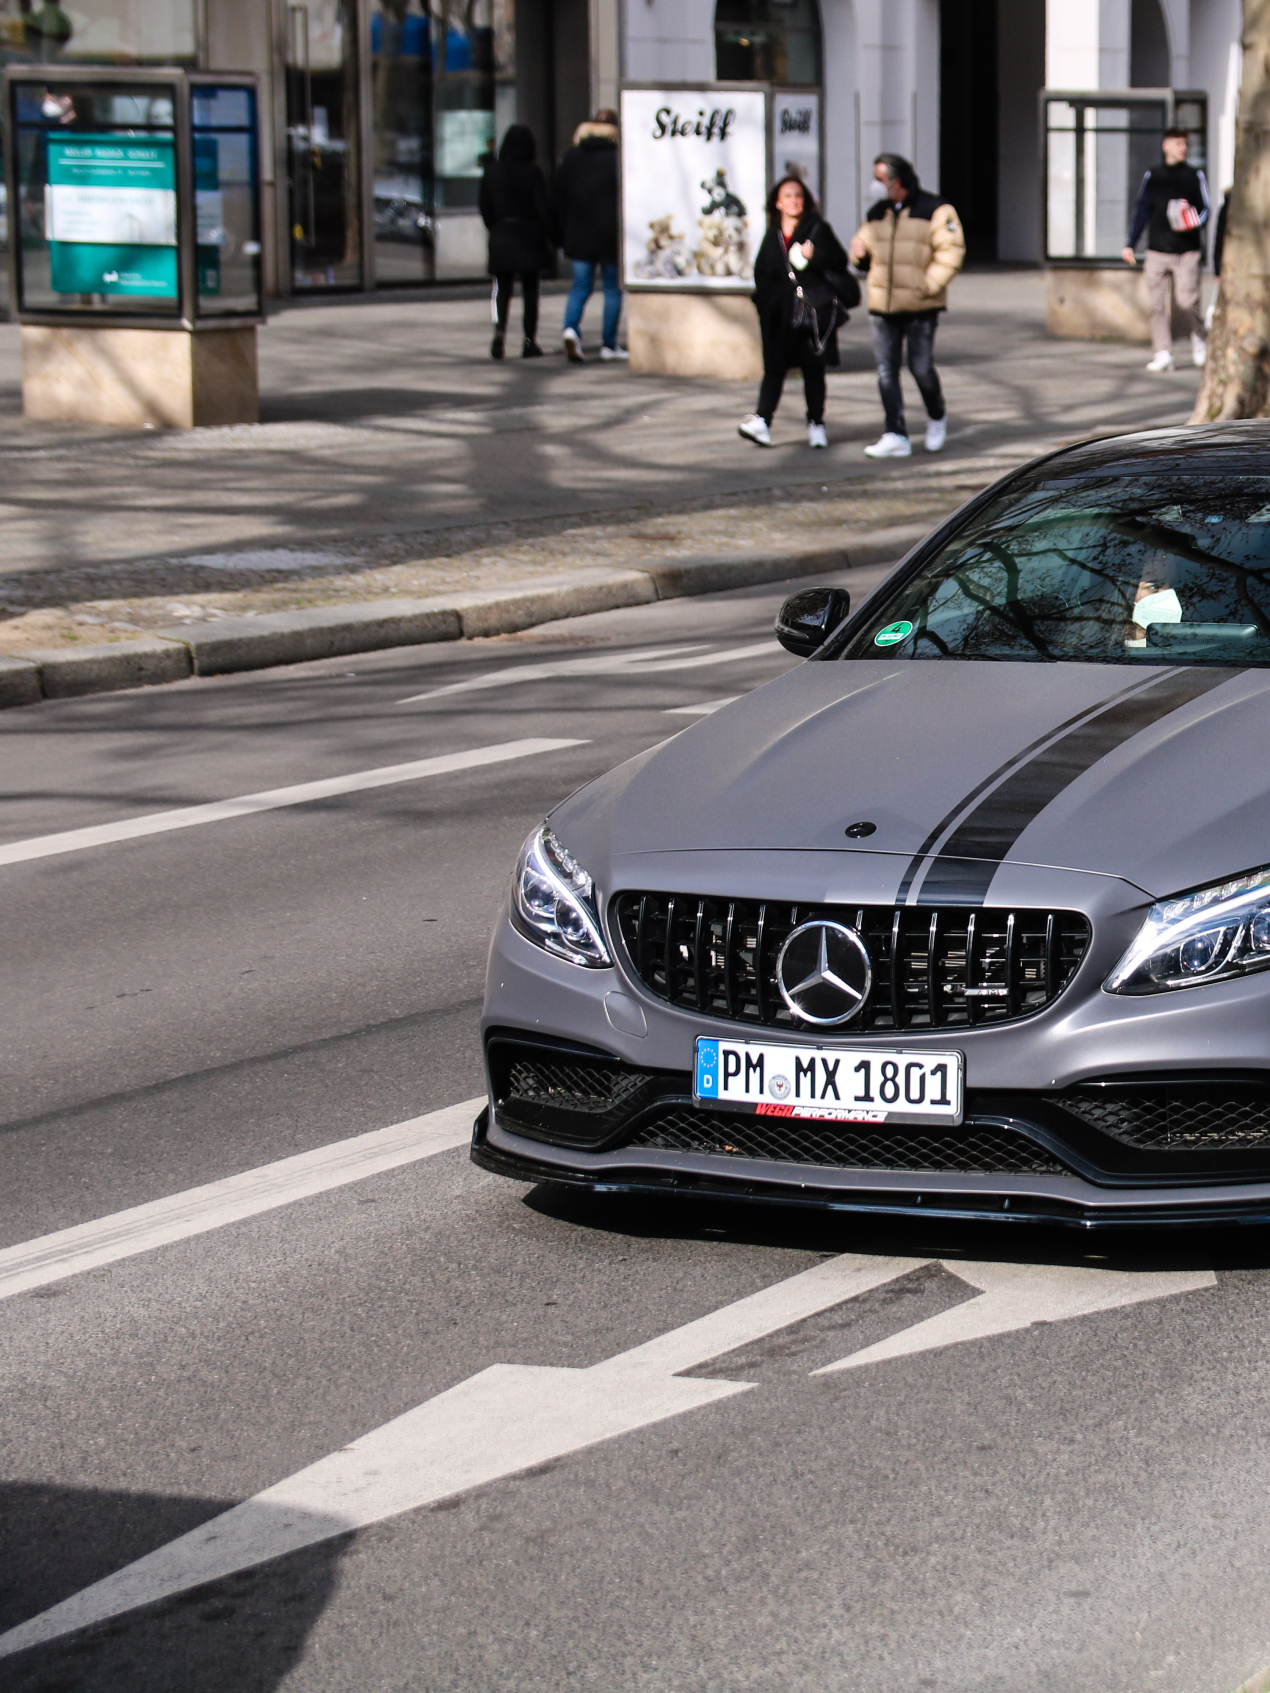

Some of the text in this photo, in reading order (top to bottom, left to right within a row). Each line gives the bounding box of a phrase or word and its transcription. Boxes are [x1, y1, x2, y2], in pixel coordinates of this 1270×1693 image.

[653, 106, 736, 142] Steiff
[703, 1075, 713, 1089] D
[722, 1049, 765, 1095] PM
[795, 1055, 841, 1101] MX
[853, 1060, 952, 1106] 1801
